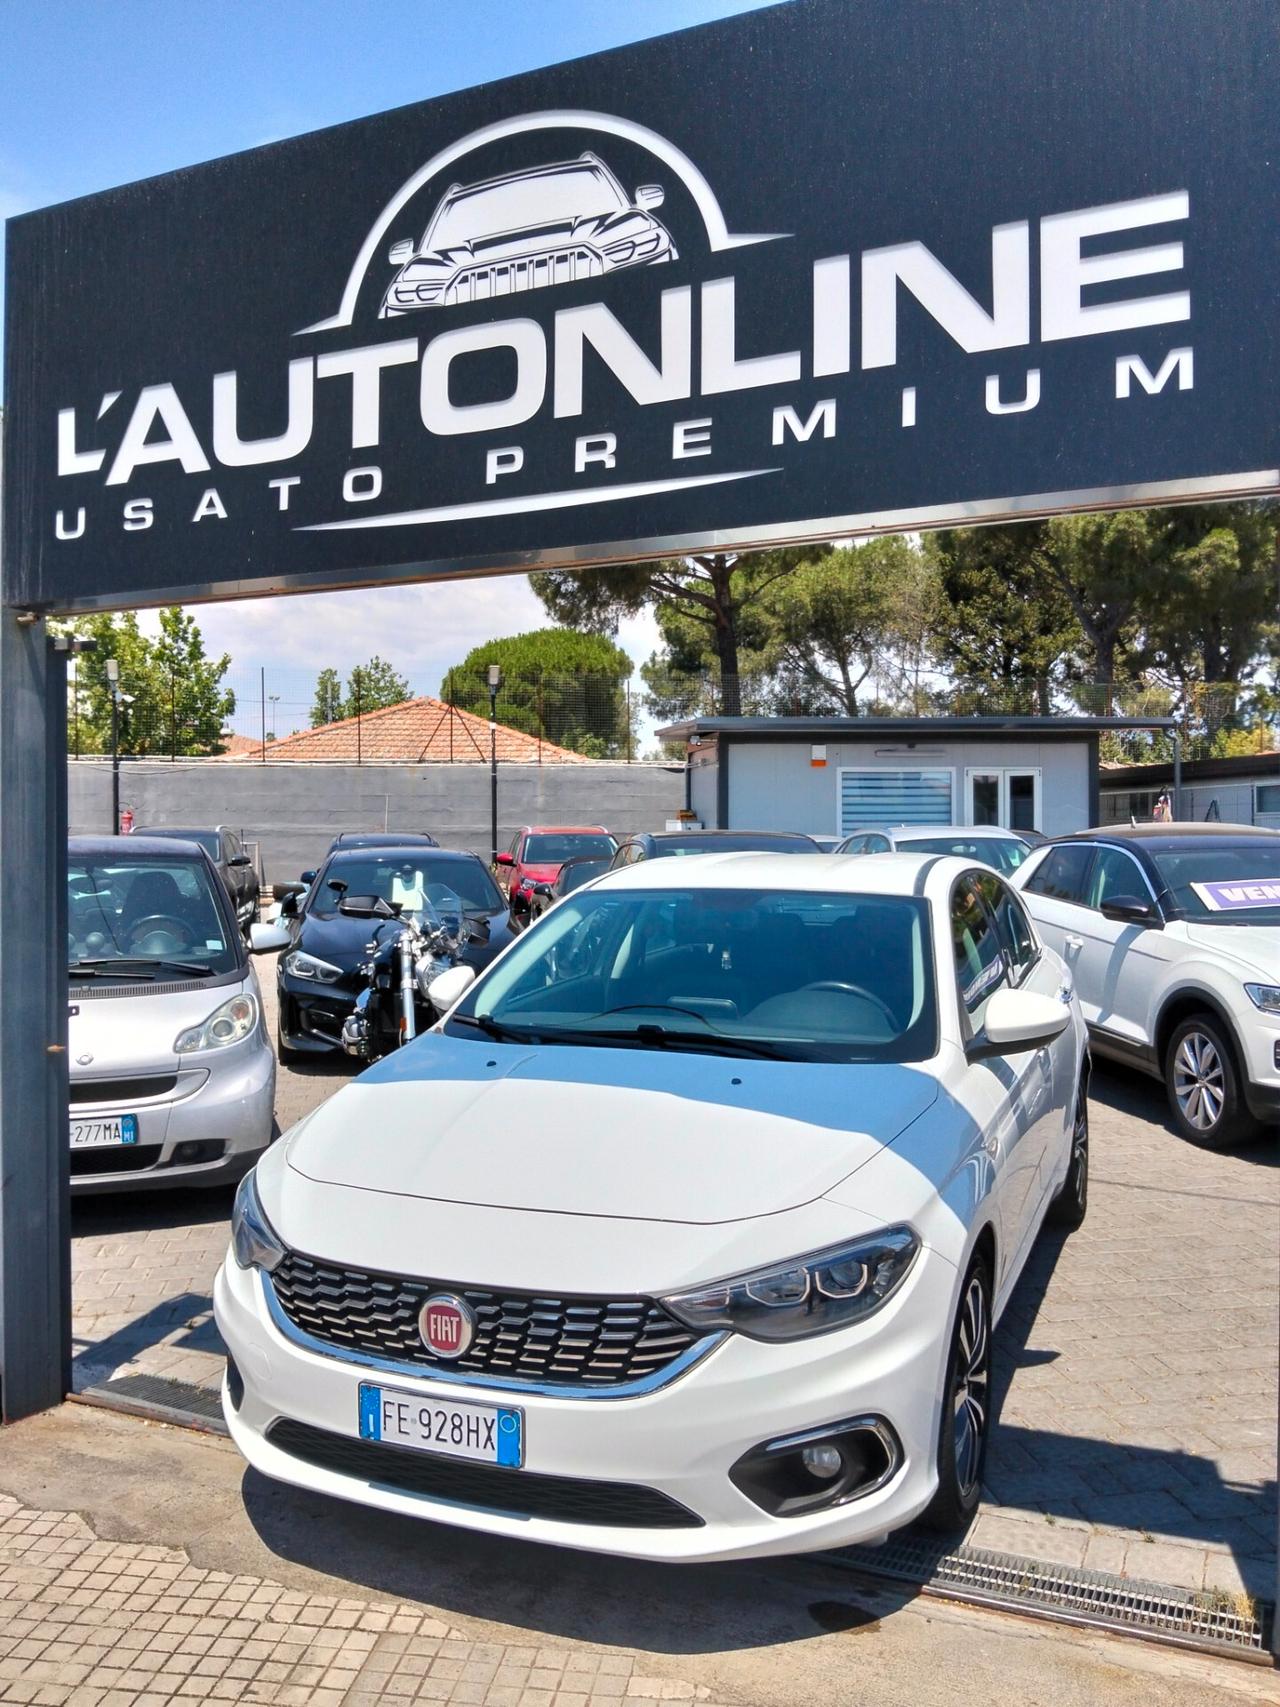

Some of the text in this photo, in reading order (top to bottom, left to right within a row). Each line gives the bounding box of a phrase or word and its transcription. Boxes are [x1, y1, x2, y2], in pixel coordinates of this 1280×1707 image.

[57, 189, 1192, 486] L'AUTONLINE
[55, 346, 1195, 540] USATO PREMIUM
[430, 1313, 460, 1343] FIAT
